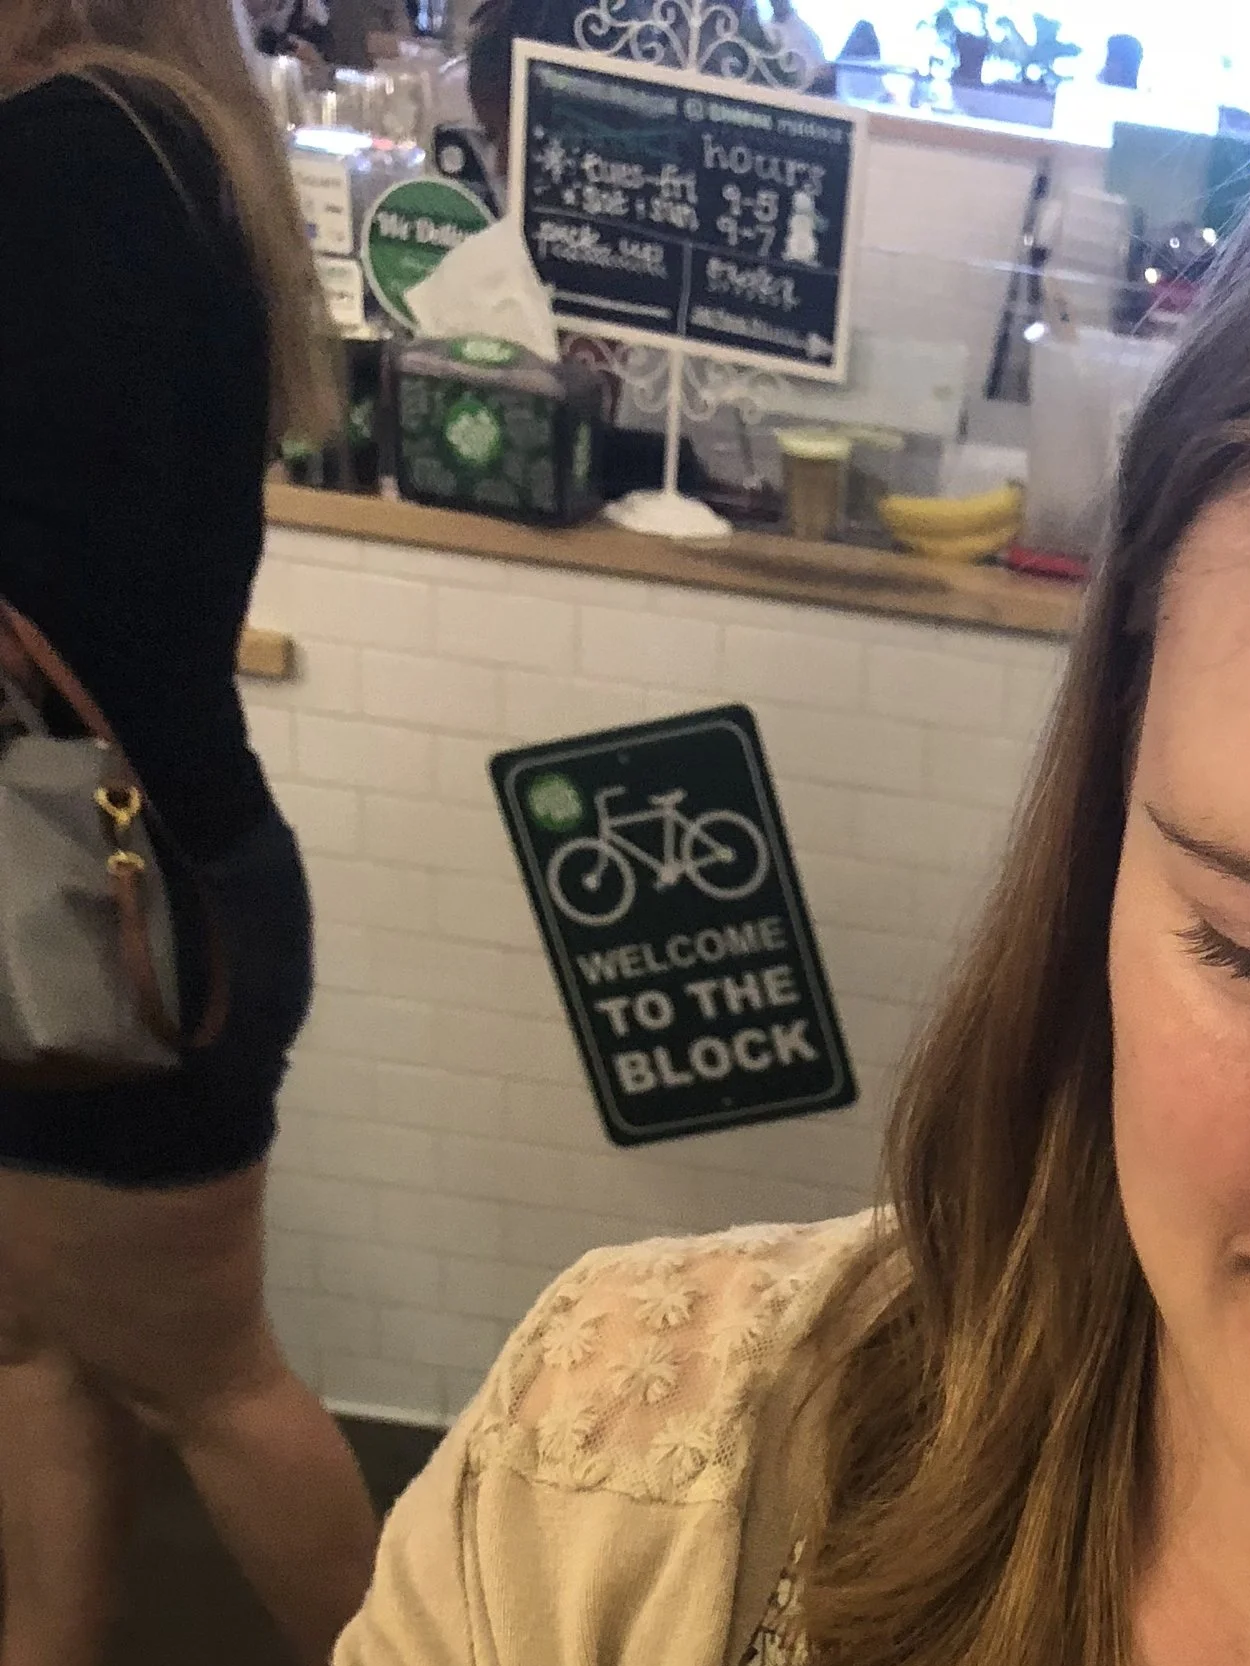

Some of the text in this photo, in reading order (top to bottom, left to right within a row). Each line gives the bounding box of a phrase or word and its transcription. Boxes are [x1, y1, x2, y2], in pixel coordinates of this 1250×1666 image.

[702, 133, 825, 197] hours
[577, 917, 786, 985] WELCOME
[594, 965, 801, 1038] TO THE
[614, 1020, 819, 1094] BLOCK
